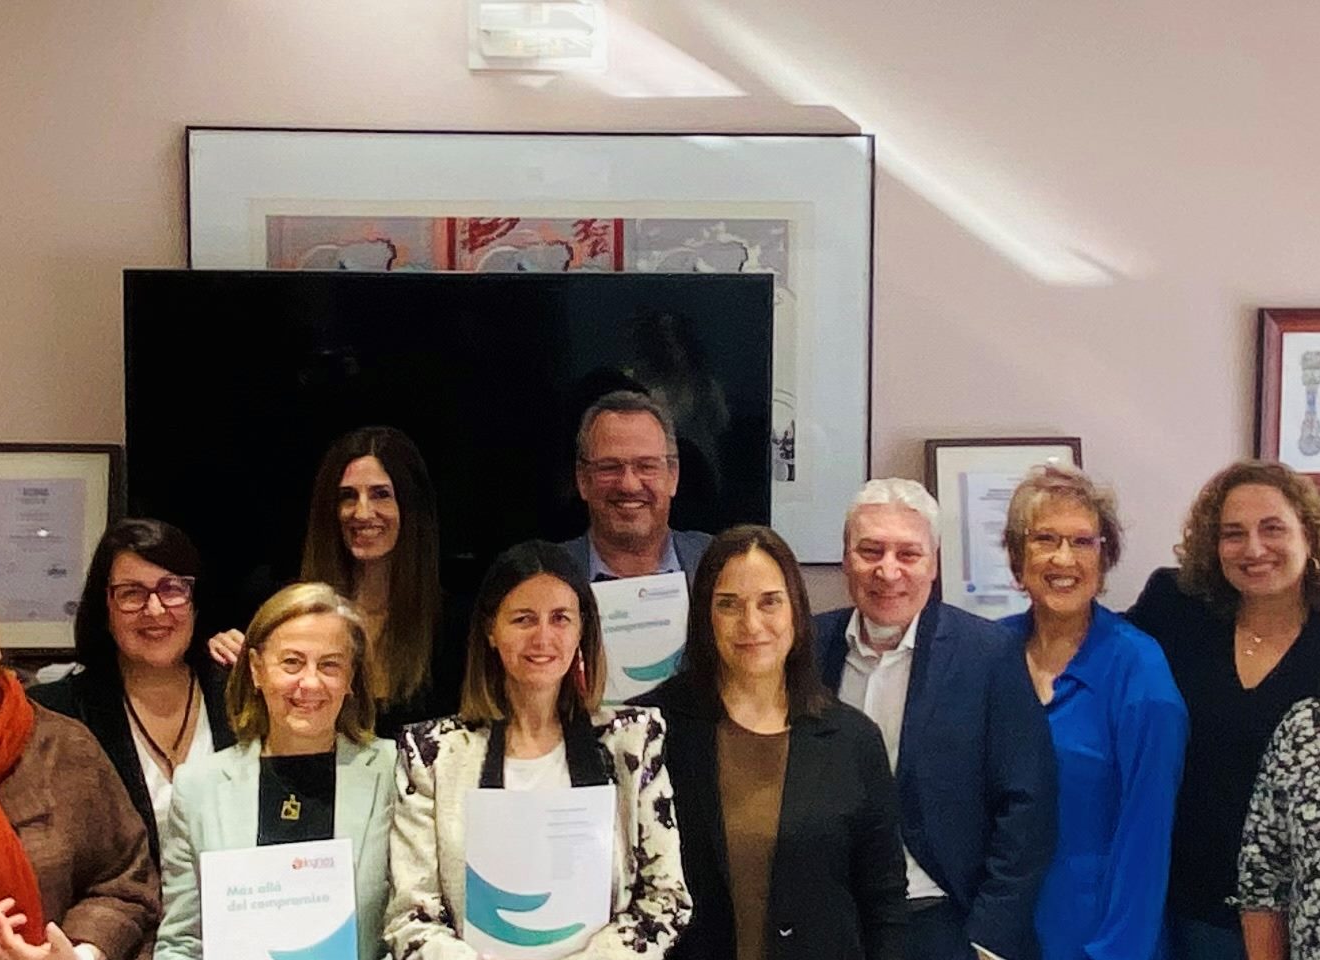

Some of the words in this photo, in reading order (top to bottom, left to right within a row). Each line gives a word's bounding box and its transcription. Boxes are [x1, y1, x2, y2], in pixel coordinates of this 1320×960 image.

[258, 881, 282, 894] allá
[227, 899, 247, 912] del
[250, 892, 330, 910] compromiso
